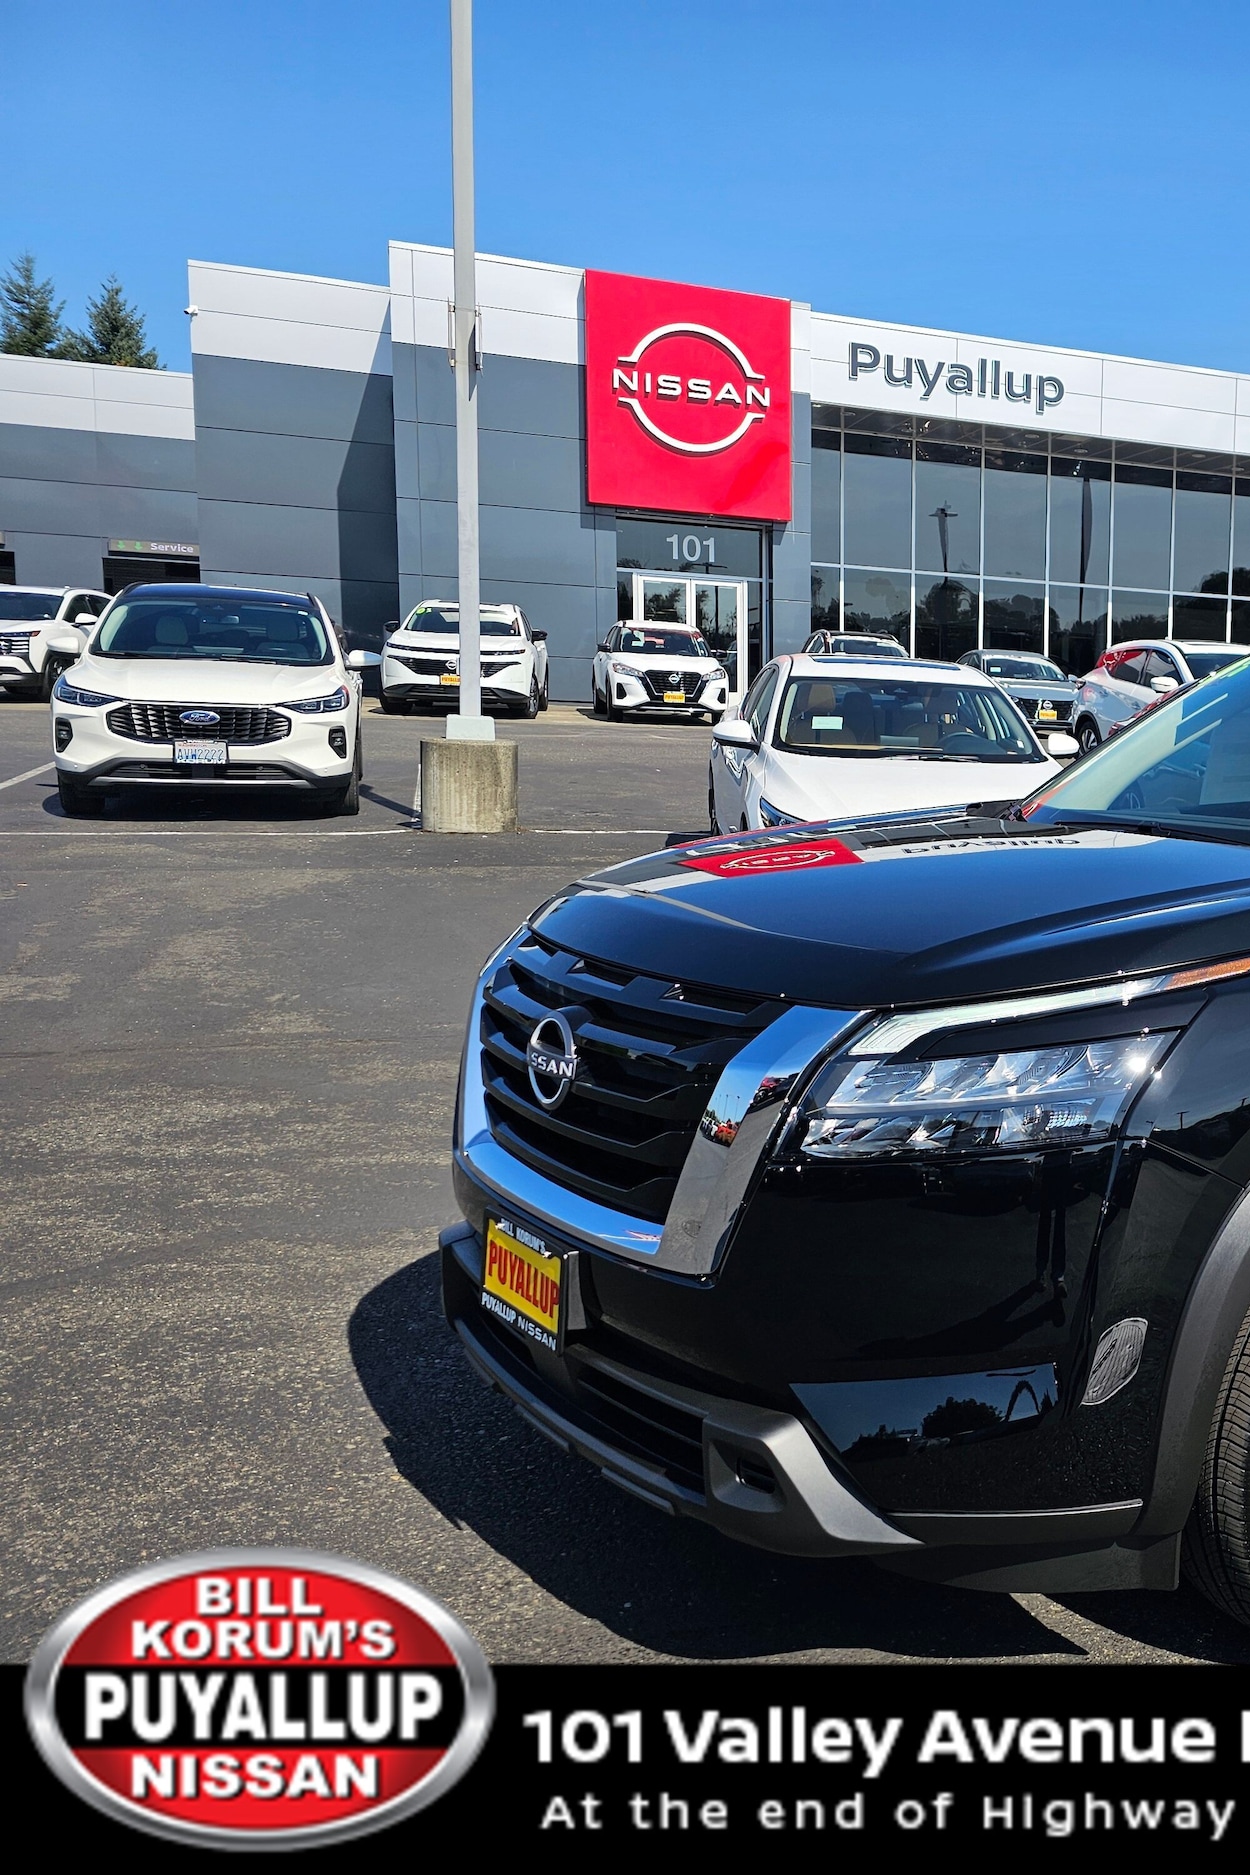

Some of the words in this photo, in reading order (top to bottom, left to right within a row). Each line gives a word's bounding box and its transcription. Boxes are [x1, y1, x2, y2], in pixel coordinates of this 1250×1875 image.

[612, 368, 771, 408] NISSAN
[848, 341, 1065, 414] Puyallup
[150, 542, 194, 553] Service
[666, 534, 716, 563] 101
[189, 713, 211, 723] Ford
[488, 1239, 560, 1319] PUYALLUP
[481, 1292, 516, 1323] PUYALLUP
[517, 1315, 556, 1352] NISSAN
